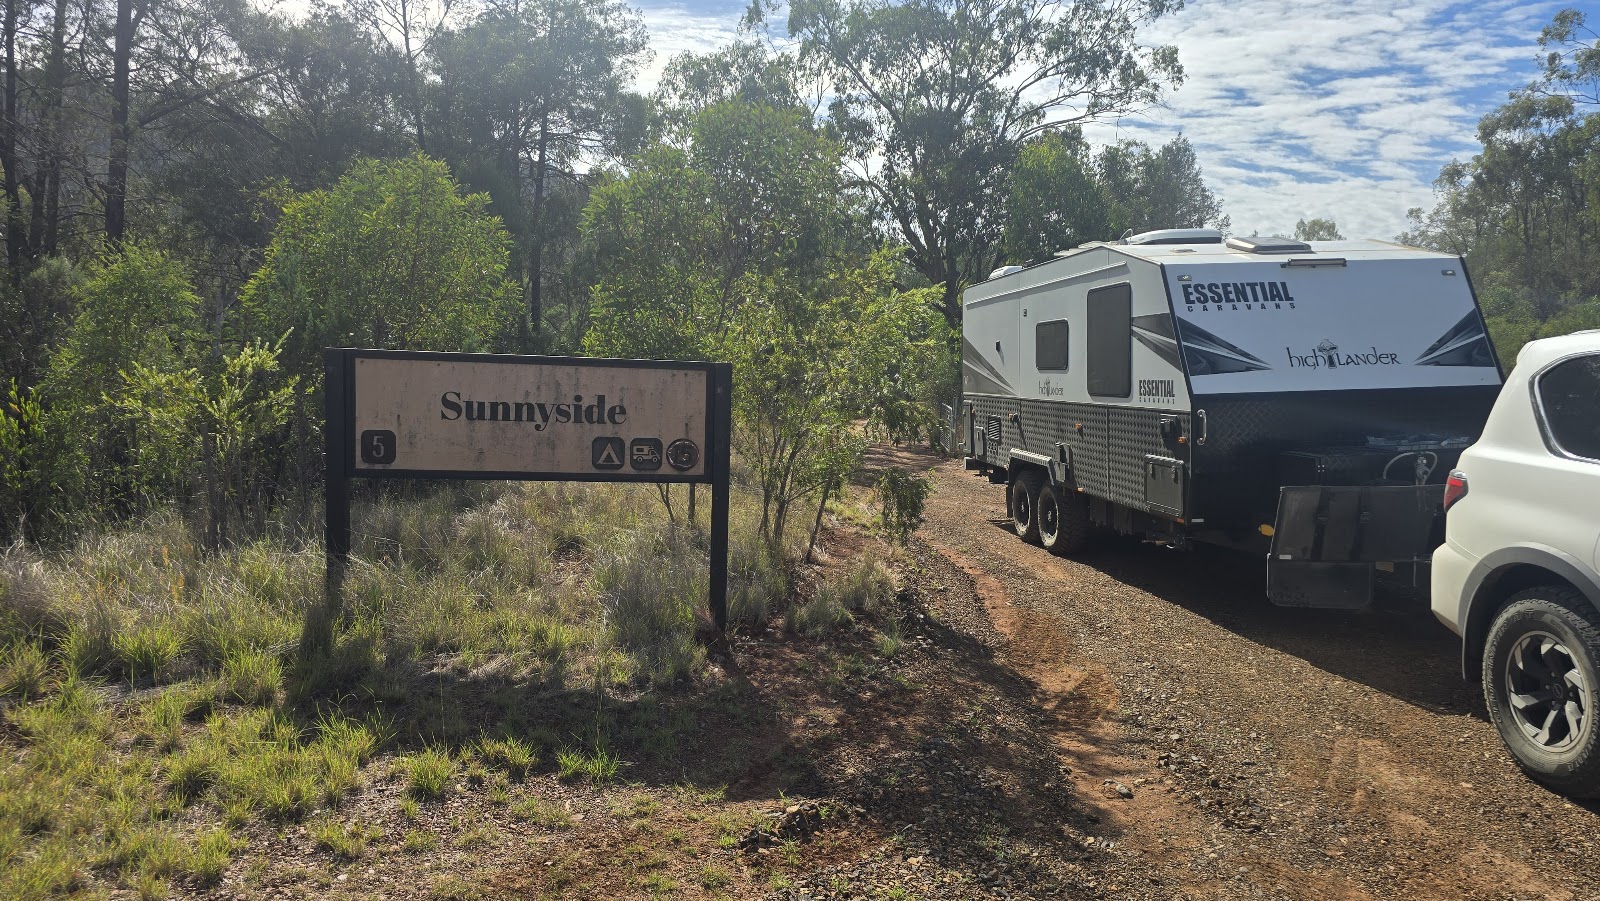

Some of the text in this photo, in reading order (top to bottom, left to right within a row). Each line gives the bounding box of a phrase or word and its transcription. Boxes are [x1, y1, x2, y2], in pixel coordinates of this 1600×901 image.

[1182, 282, 1294, 304] ESSENTIAL
[1187, 303, 1296, 312] CARAVANS
[1139, 379, 1175, 397] ESSENTIAL
[440, 391, 627, 431] Sunnyside
[372, 435, 385, 458] 5
